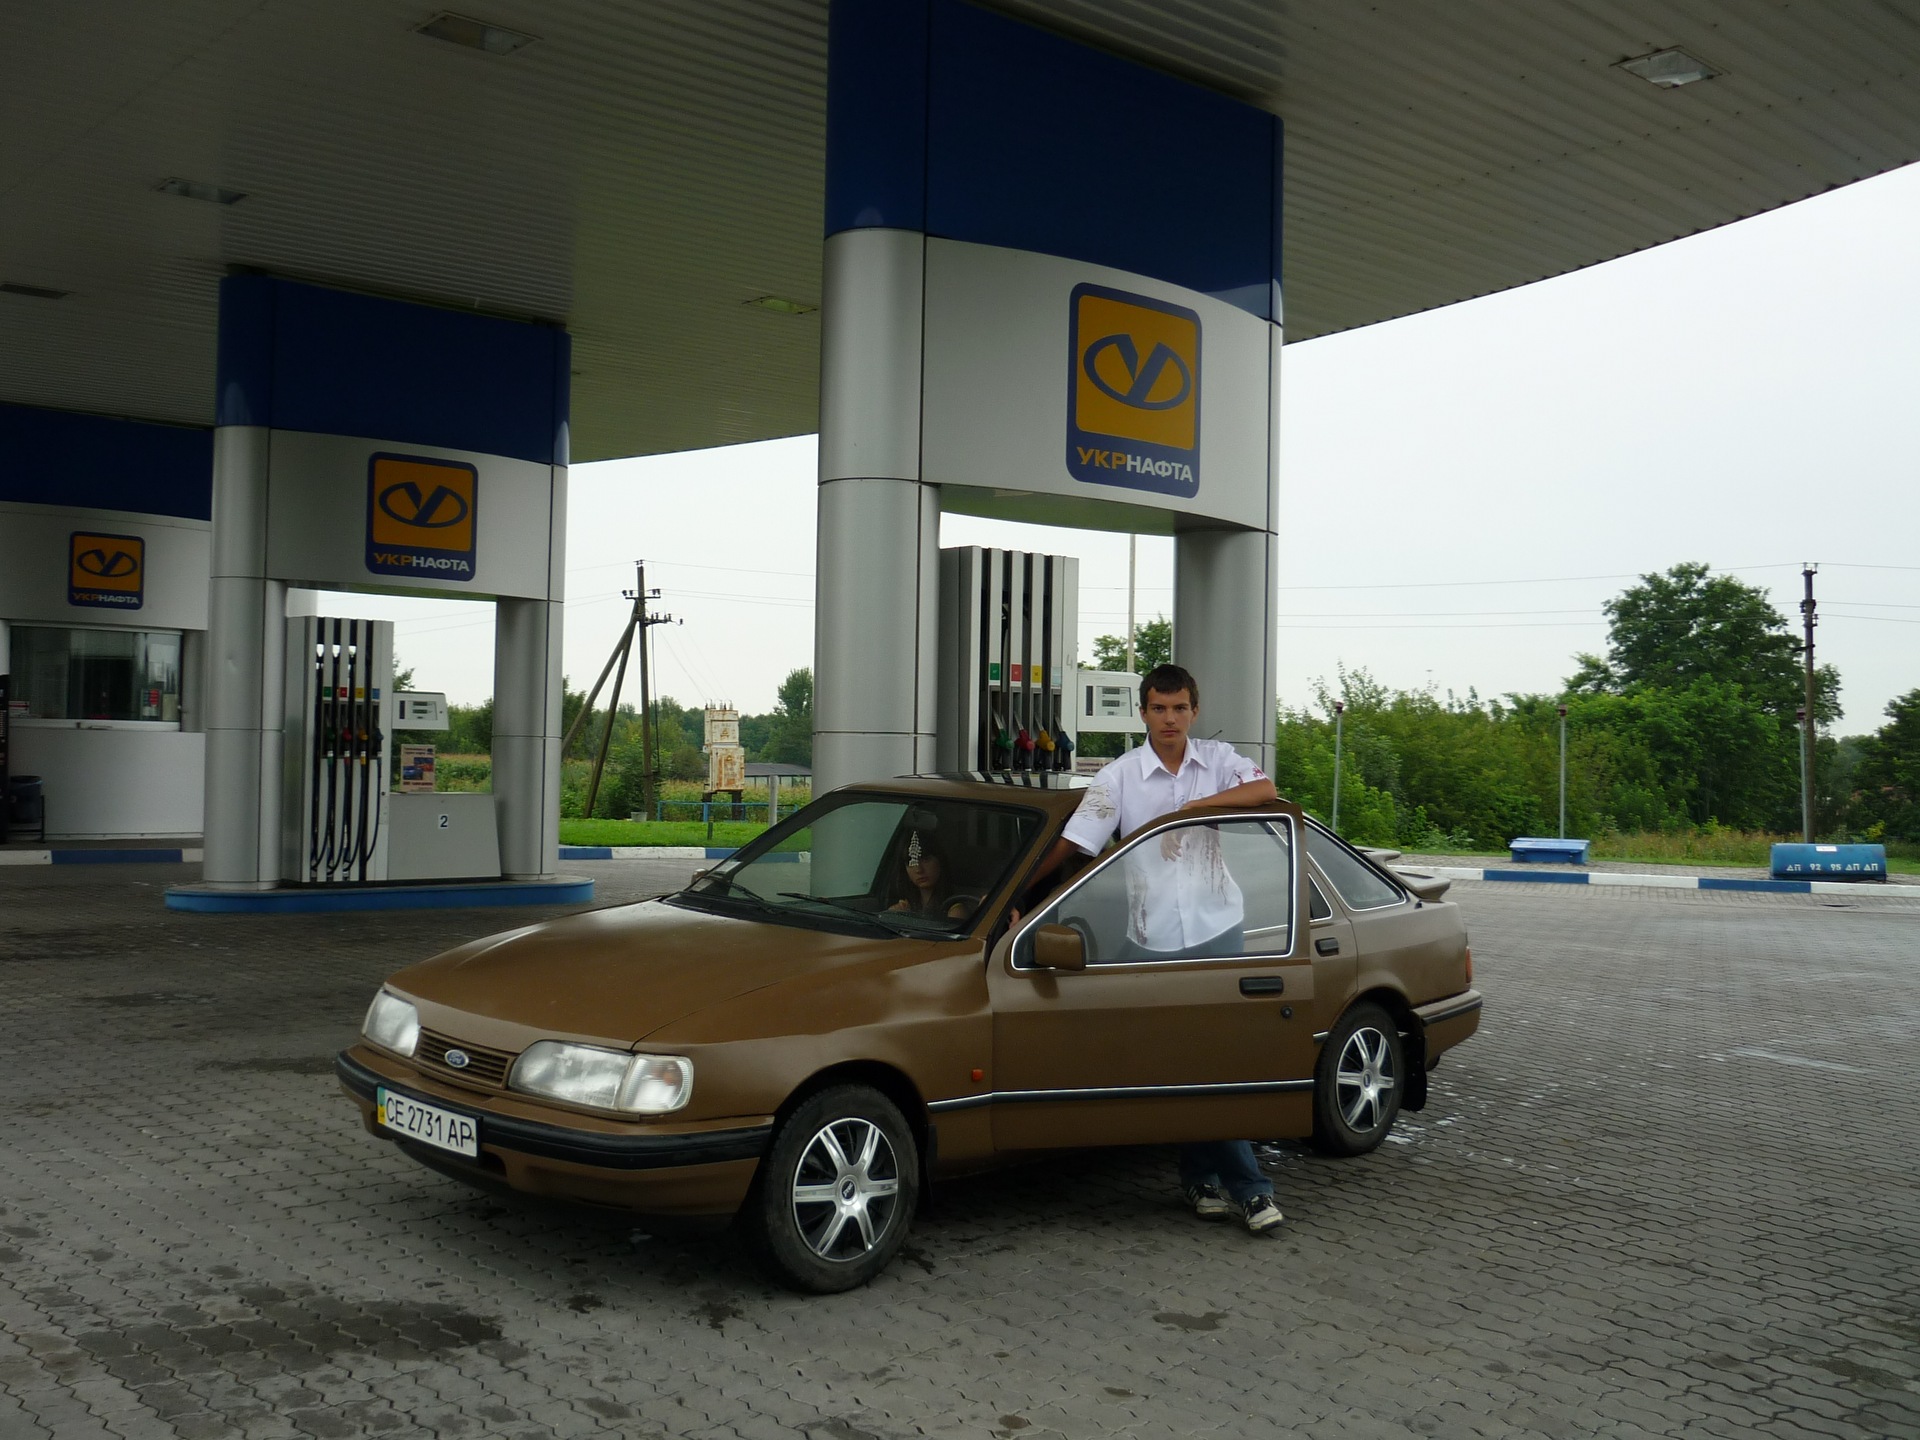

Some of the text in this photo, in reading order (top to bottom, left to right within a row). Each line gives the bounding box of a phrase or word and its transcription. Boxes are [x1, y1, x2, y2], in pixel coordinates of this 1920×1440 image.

[1076, 446, 1194, 483] УКРНАФТА
[373, 552, 470, 572] УКРНАФТА
[439, 815, 448, 828] 2
[1809, 863, 1821, 871] 92
[1830, 863, 1842, 871] 95
[386, 1097, 473, 1148] CE 2731 AP
